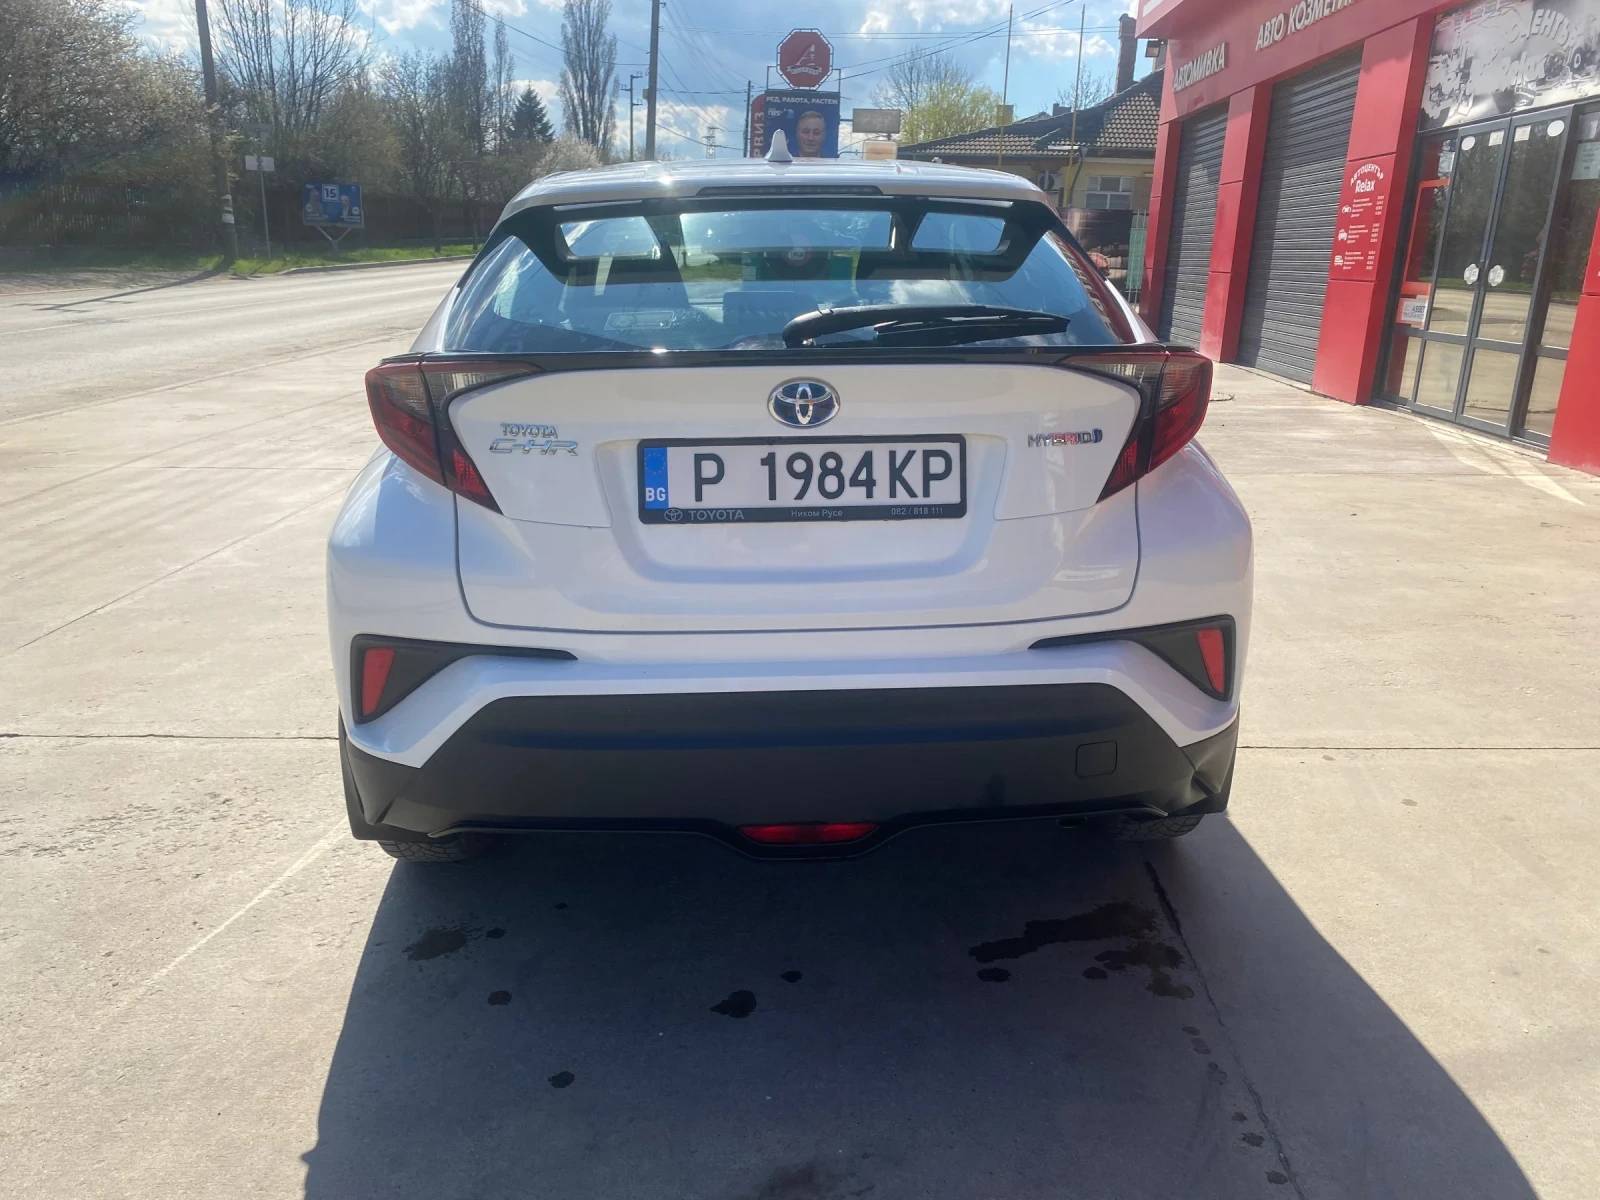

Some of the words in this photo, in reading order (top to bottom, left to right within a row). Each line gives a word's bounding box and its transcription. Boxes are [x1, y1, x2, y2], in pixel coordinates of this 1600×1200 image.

[1255, 13, 1285, 51] АВТО
[1287, 0, 1356, 35] КОЗМЕ
[1173, 42, 1225, 92] АВТОМИВКА
[782, 97, 810, 105] РАБОТА,
[324, 188, 337, 199] 15
[1355, 178, 1376, 194] Relax
[500, 422, 558, 439] TOYOTA
[489, 438, 578, 456] C-HR
[1028, 431, 1092, 448] HYBRID
[694, 453, 725, 502] P
[645, 487, 666, 502] BG
[688, 509, 744, 520] TOYOTA
[791, 509, 820, 518] Ником
[822, 508, 843, 519] Русе
[891, 507, 906, 516] 082
[913, 506, 929, 515] 818
[931, 505, 943, 515] 111
